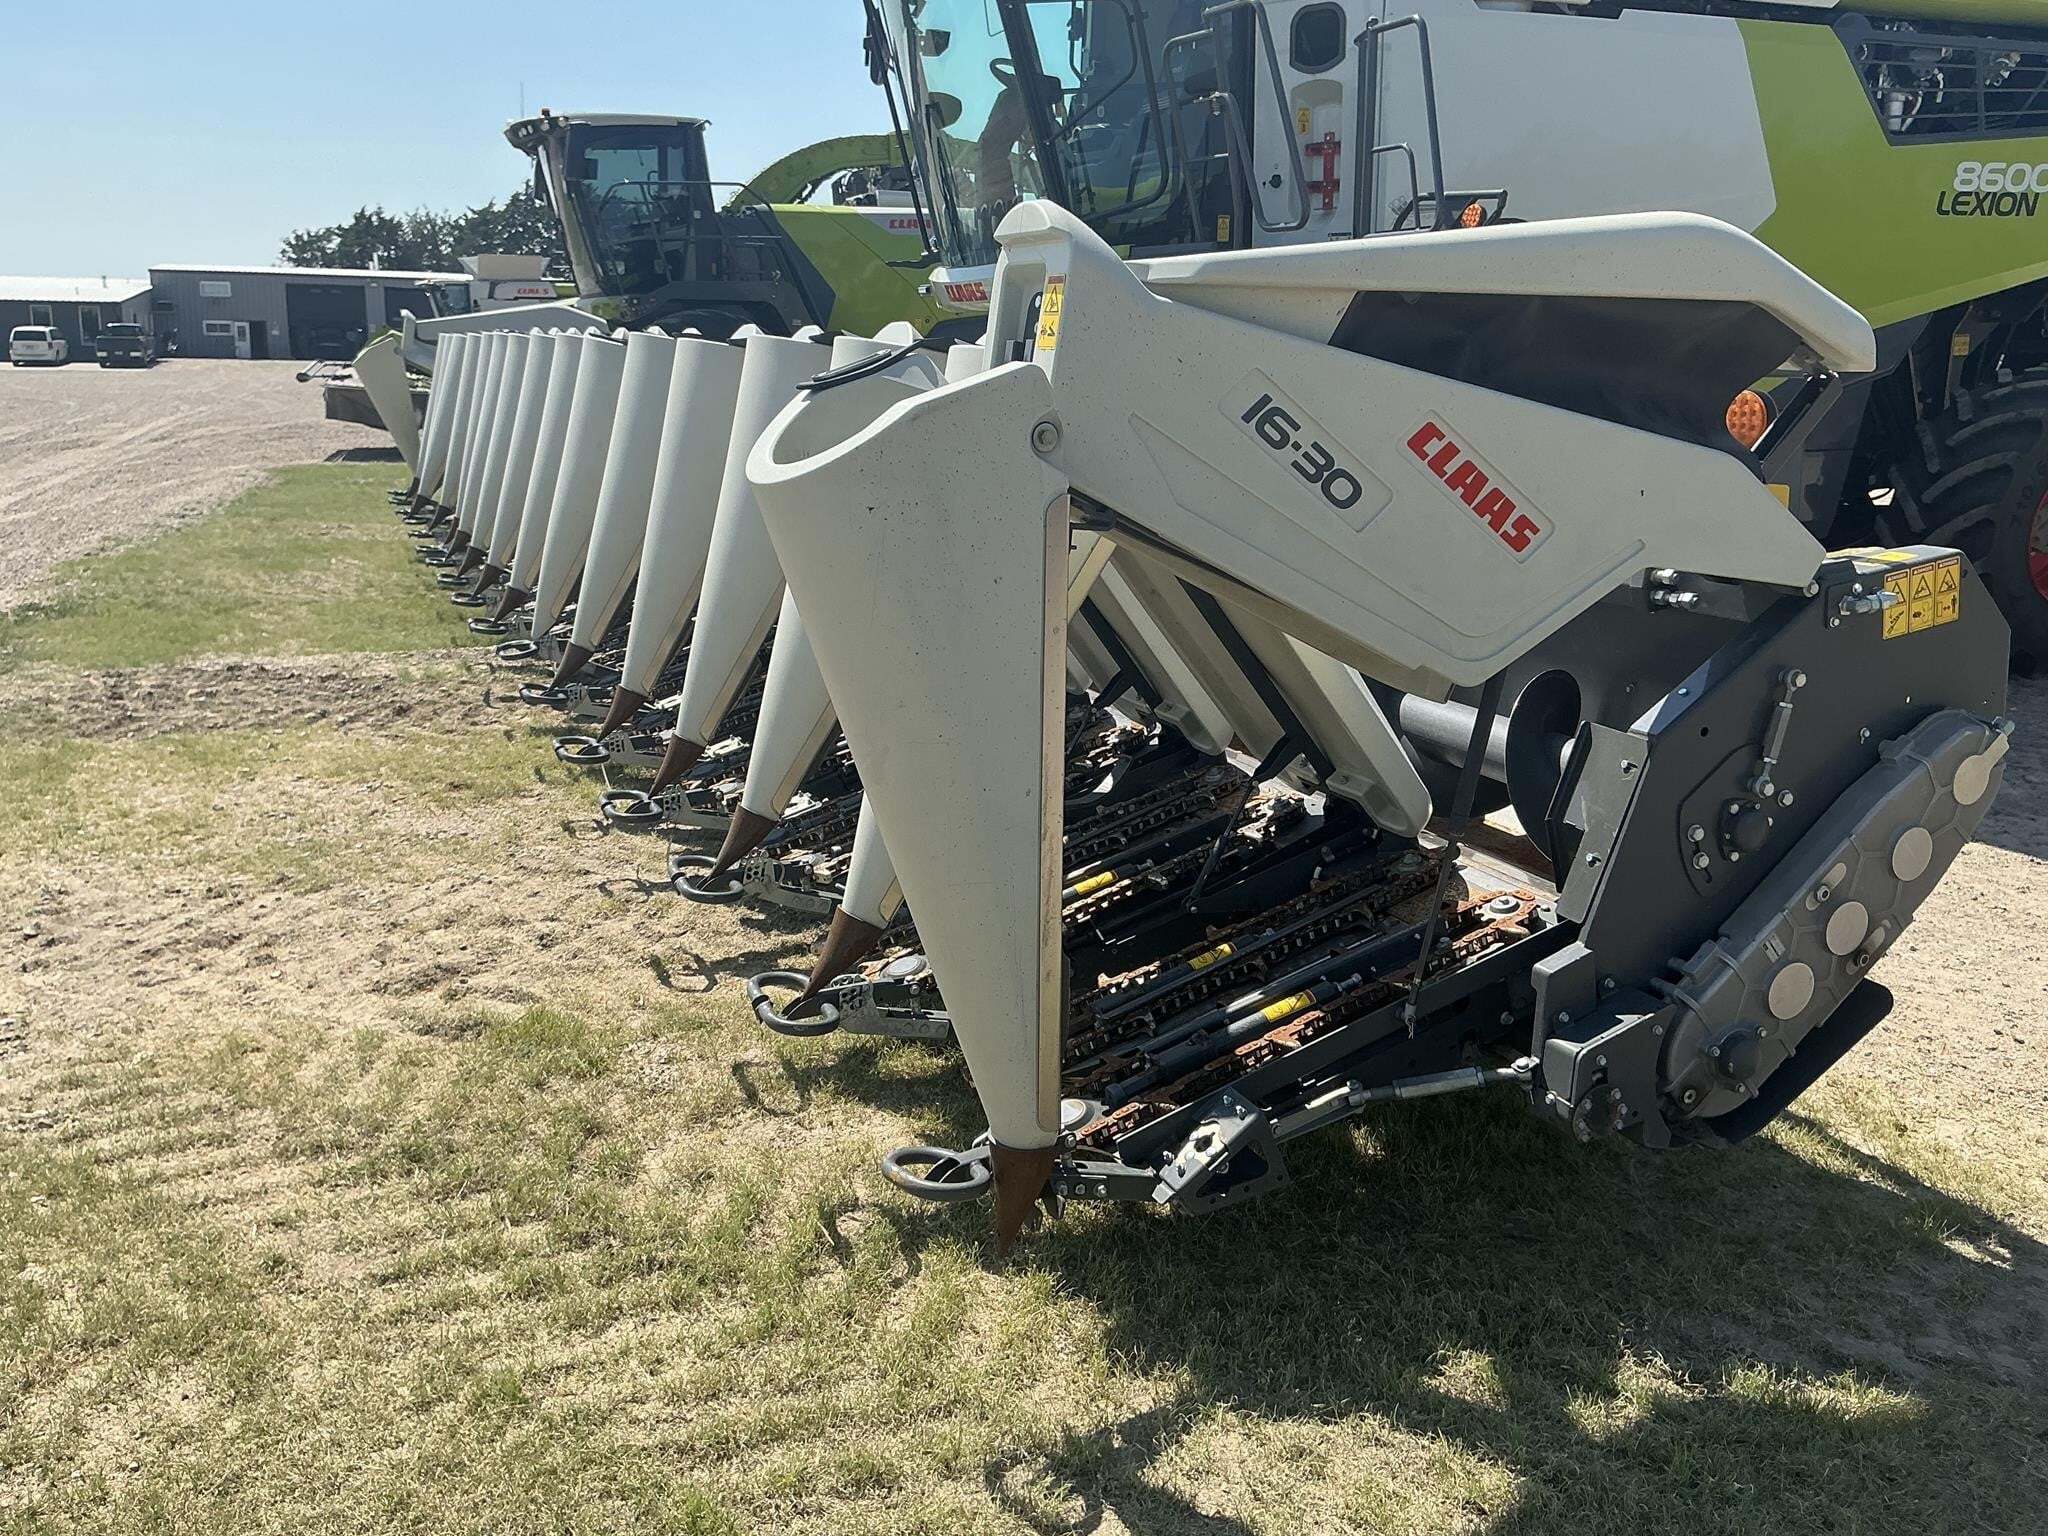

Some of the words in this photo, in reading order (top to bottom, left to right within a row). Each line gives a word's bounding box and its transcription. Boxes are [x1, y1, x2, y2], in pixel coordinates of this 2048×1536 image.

[1953, 161, 2048, 193] 8600
[1936, 191, 2040, 217] LEXION
[889, 219, 931, 229] CLA
[1406, 421, 1541, 552] CLAAS
